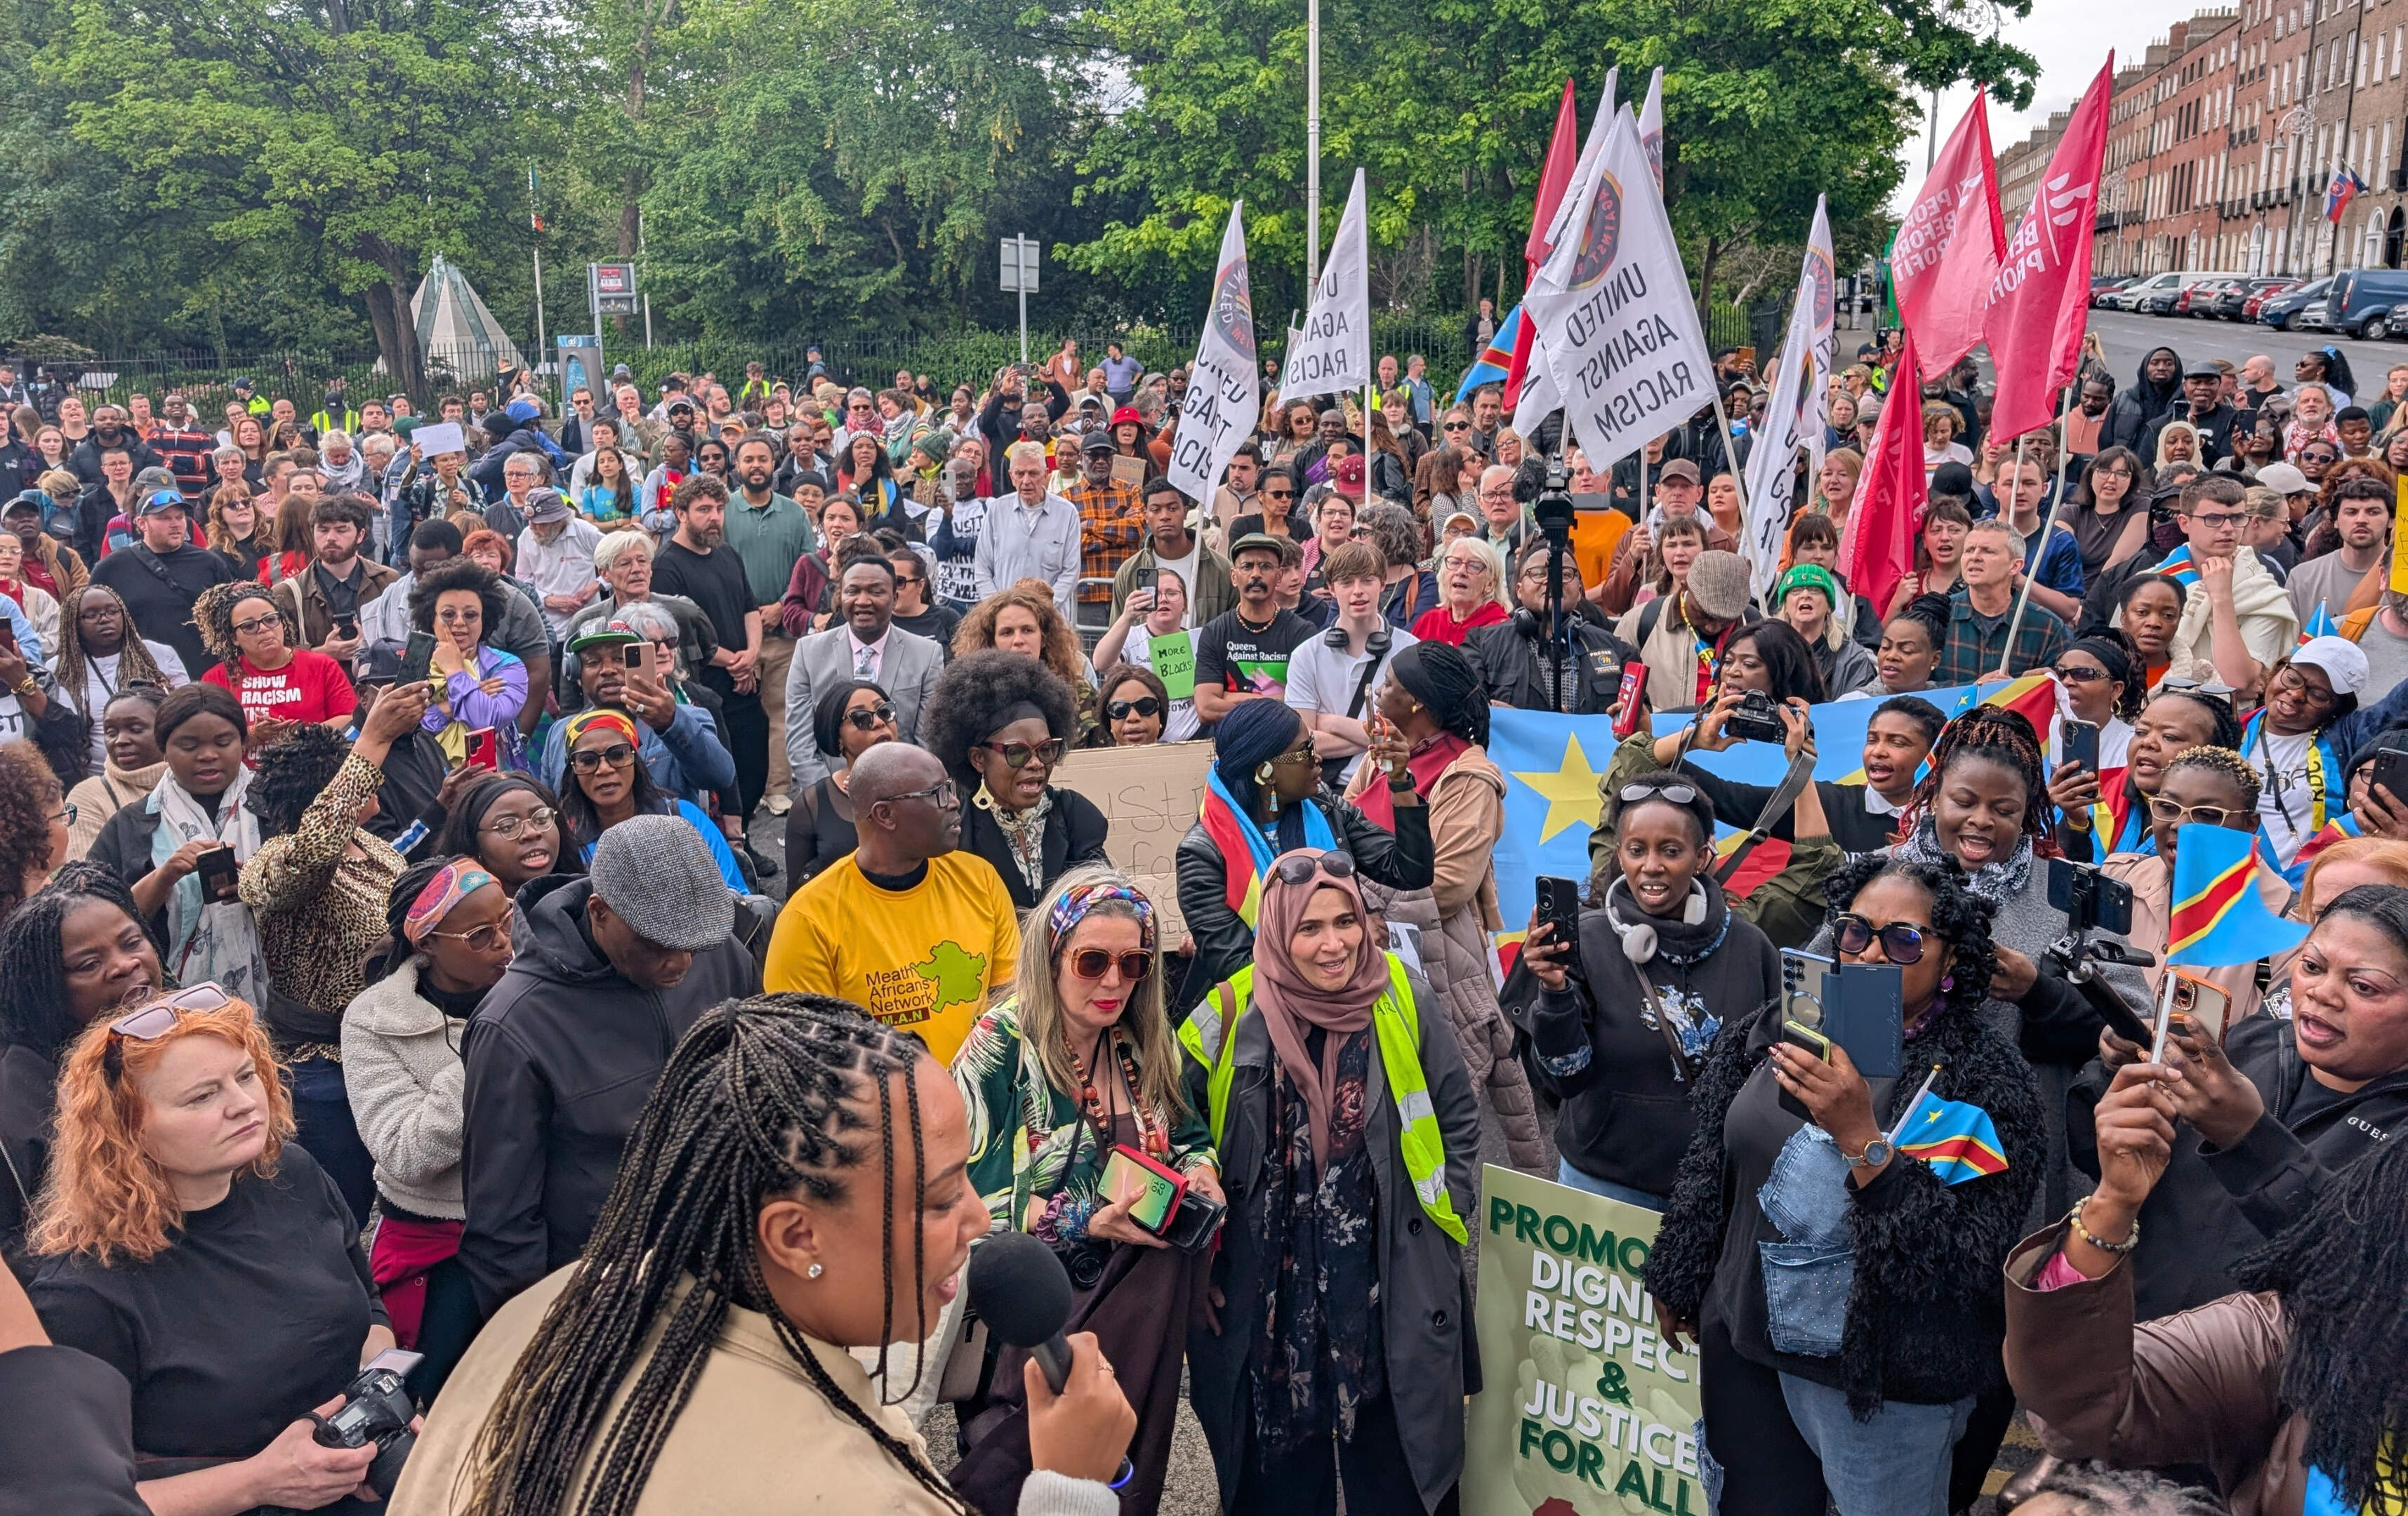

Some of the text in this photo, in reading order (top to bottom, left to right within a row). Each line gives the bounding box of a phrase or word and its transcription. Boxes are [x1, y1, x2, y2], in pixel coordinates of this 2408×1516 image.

[1157, 646, 1186, 659] MORE
[1226, 641, 1257, 652] Queers
[1226, 652, 1289, 662] Against Racism
[242, 674, 287, 689] SHOW
[241, 688, 302, 705] RACISM
[866, 966, 914, 987] Meath
[869, 979, 930, 1001] Africans
[871, 990, 934, 1014] Network
[881, 1010, 923, 1025] M.A.N
[2347, 1117, 2390, 1142] GUES
[1489, 1195, 1652, 1277] PROMO
[1531, 1249, 1655, 1326] DIGNI
[1596, 1360, 1634, 1410] &
[1523, 1378, 1699, 1477] JUSTICE
[1519, 1418, 1693, 1516] FOR ALL
